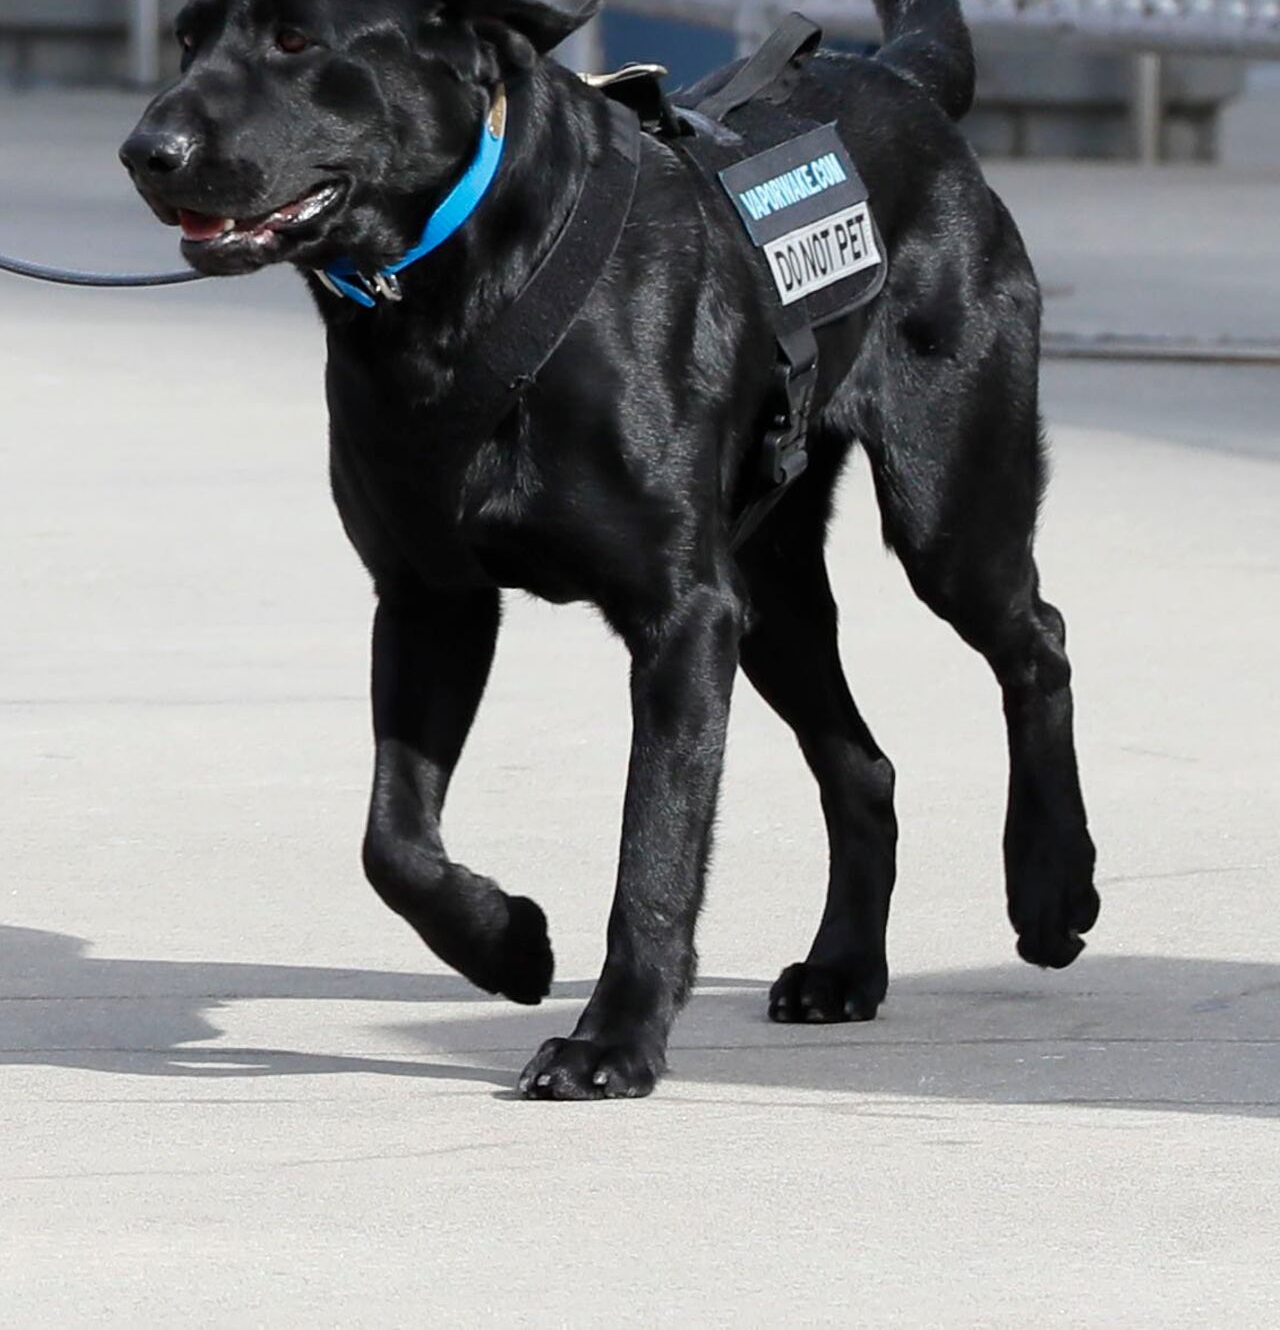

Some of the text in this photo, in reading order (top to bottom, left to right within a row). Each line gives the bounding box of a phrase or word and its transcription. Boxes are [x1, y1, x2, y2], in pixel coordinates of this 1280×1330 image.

[739, 152, 847, 220] VAPORWAKE.COM
[774, 214, 869, 292] DO NOT PET
